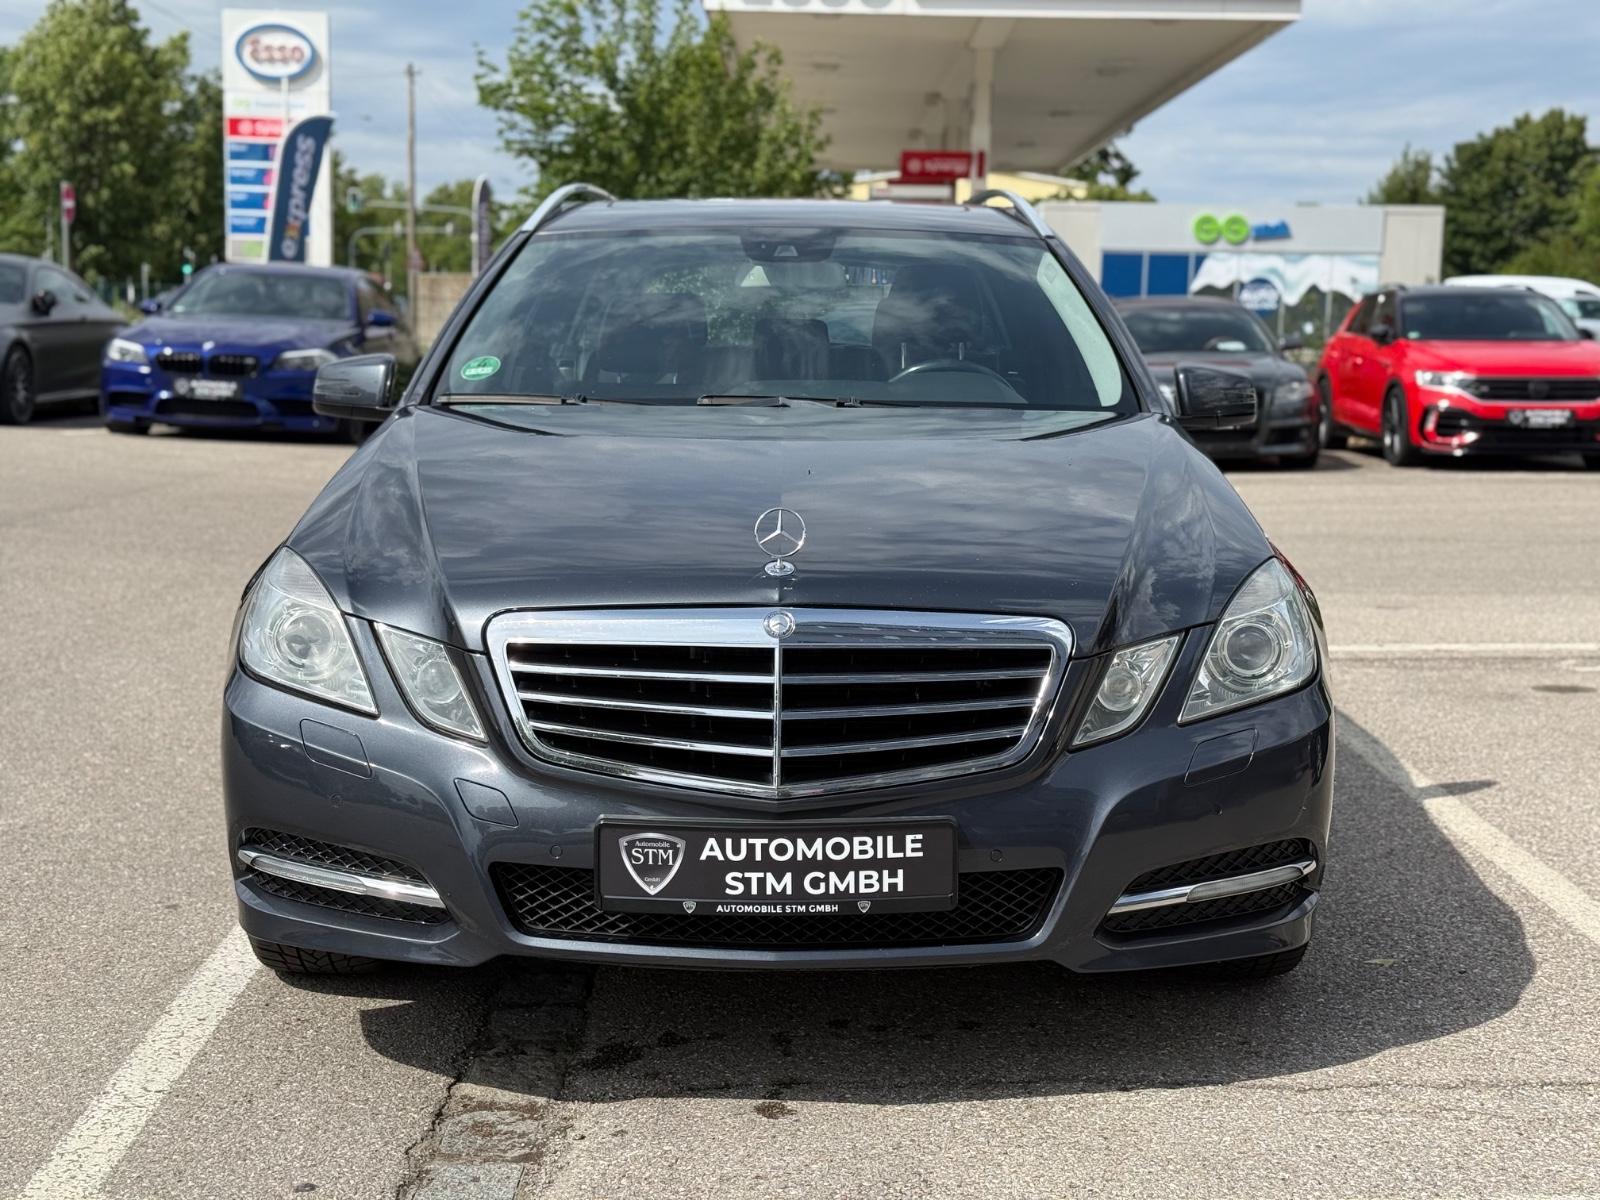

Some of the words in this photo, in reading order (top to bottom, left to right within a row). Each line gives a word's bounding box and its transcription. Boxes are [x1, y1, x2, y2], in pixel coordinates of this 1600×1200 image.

[247, 36, 304, 64] Esso
[635, 840, 670, 848] Automobile
[699, 834, 924, 862] AUTOMOBILE
[631, 848, 675, 866] STM
[725, 871, 793, 896] STM
[803, 868, 904, 895] GMBH
[716, 904, 782, 914] AUTOMOBILE
[785, 905, 806, 913] STM
[808, 904, 839, 912] GMBH
